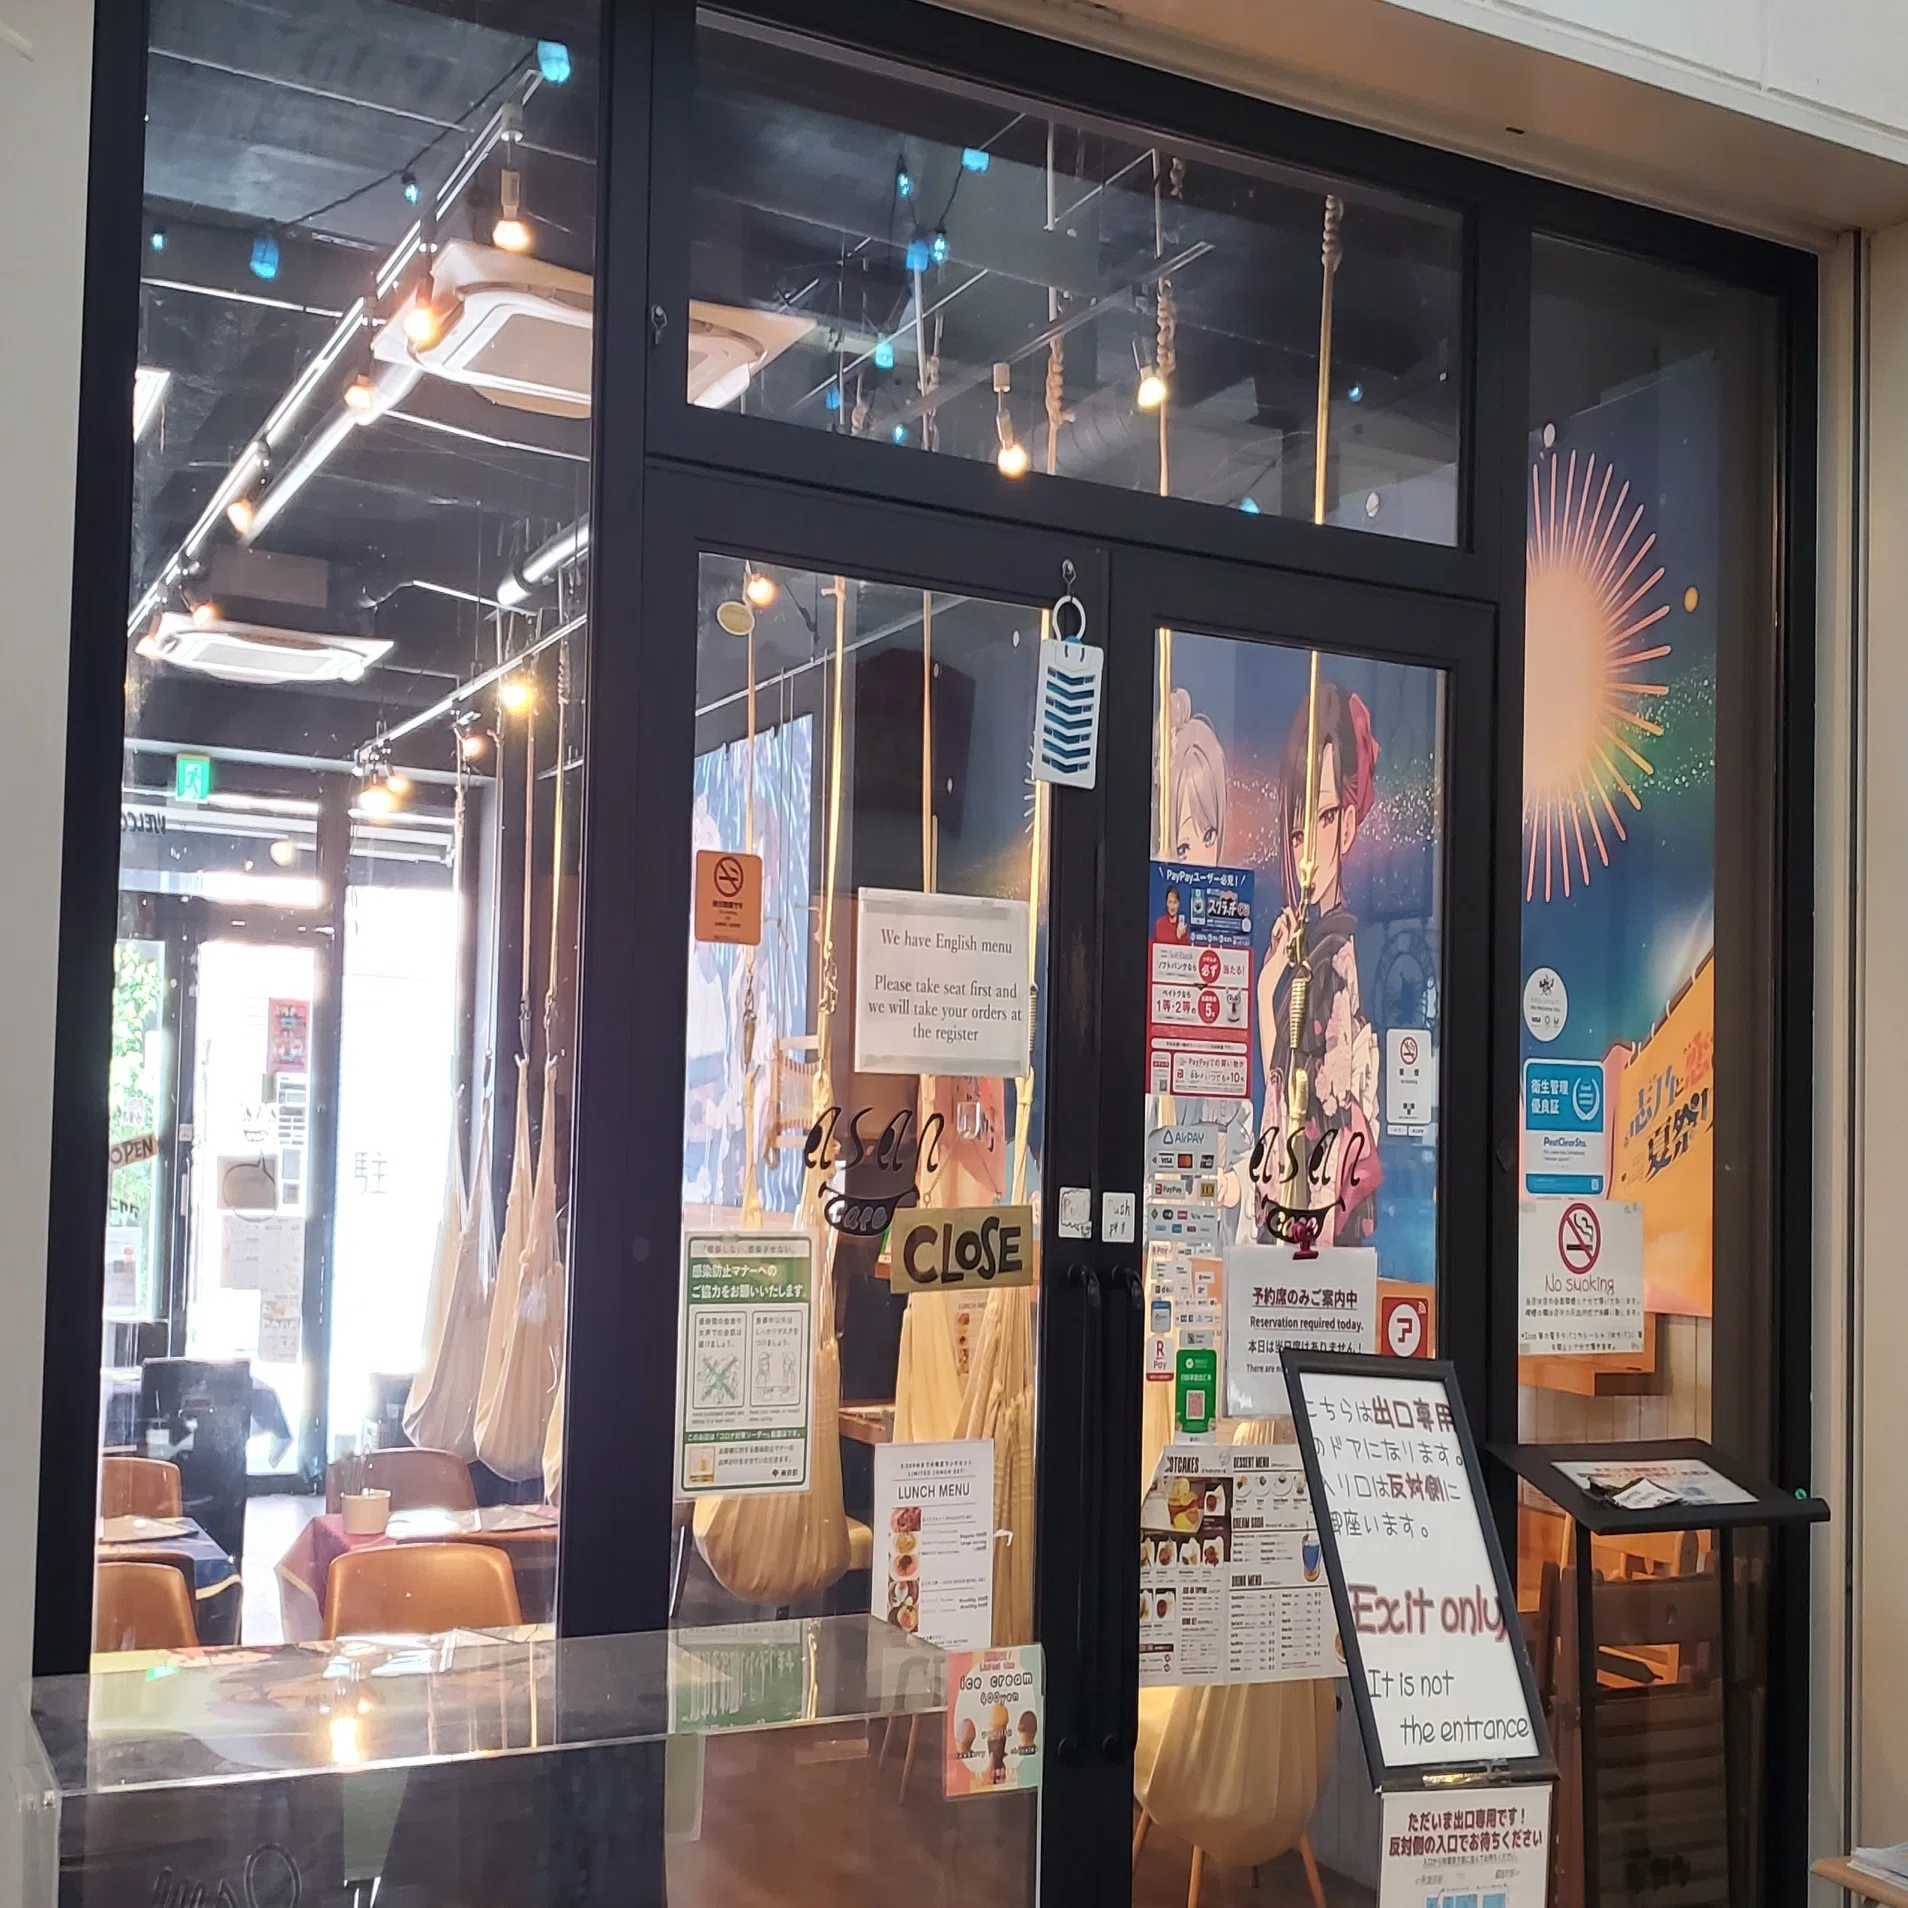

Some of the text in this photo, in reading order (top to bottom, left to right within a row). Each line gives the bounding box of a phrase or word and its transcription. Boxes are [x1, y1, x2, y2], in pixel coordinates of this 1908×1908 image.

[881, 928, 1012, 954] We have English menu
[874, 974, 1017, 999] Please take seat first and
[868, 999, 1022, 1021] we will take your orders at
[913, 1022, 979, 1044] the register
[1530, 1079, 1569, 1096] 衛生管理
[109, 1139, 153, 1165] OPEN
[903, 1216, 1023, 1285] CLOSE
[692, 1264, 778, 1278] 感染防止マナーへの
[1545, 1274, 1562, 1293] No
[1252, 1286, 1358, 1308] 予約席のみご案内中
[1250, 1316, 1364, 1333] Reservation required today.
[1156, 1340, 1165, 1357] R
[1154, 1361, 1168, 1370] Pay
[1246, 1364, 1264, 1373] There
[1164, 1456, 1200, 1473] OTCAKES
[1234, 1456, 1270, 1468] DESSERT MENU
[898, 1482, 970, 1500] LUNCH MENU
[1248, 1574, 1262, 1586] MENU
[1348, 1582, 1434, 1635] Exit
[1440, 1584, 1508, 1642] only
[990, 1672, 1033, 1689] cream
[1368, 1669, 1454, 1698] It is not
[1400, 1714, 1530, 1746] the entrance
[1408, 1807, 1526, 1832] ただいま出口専用です！
[1389, 1829, 1543, 1857] 反対側の入口でお待ちください
